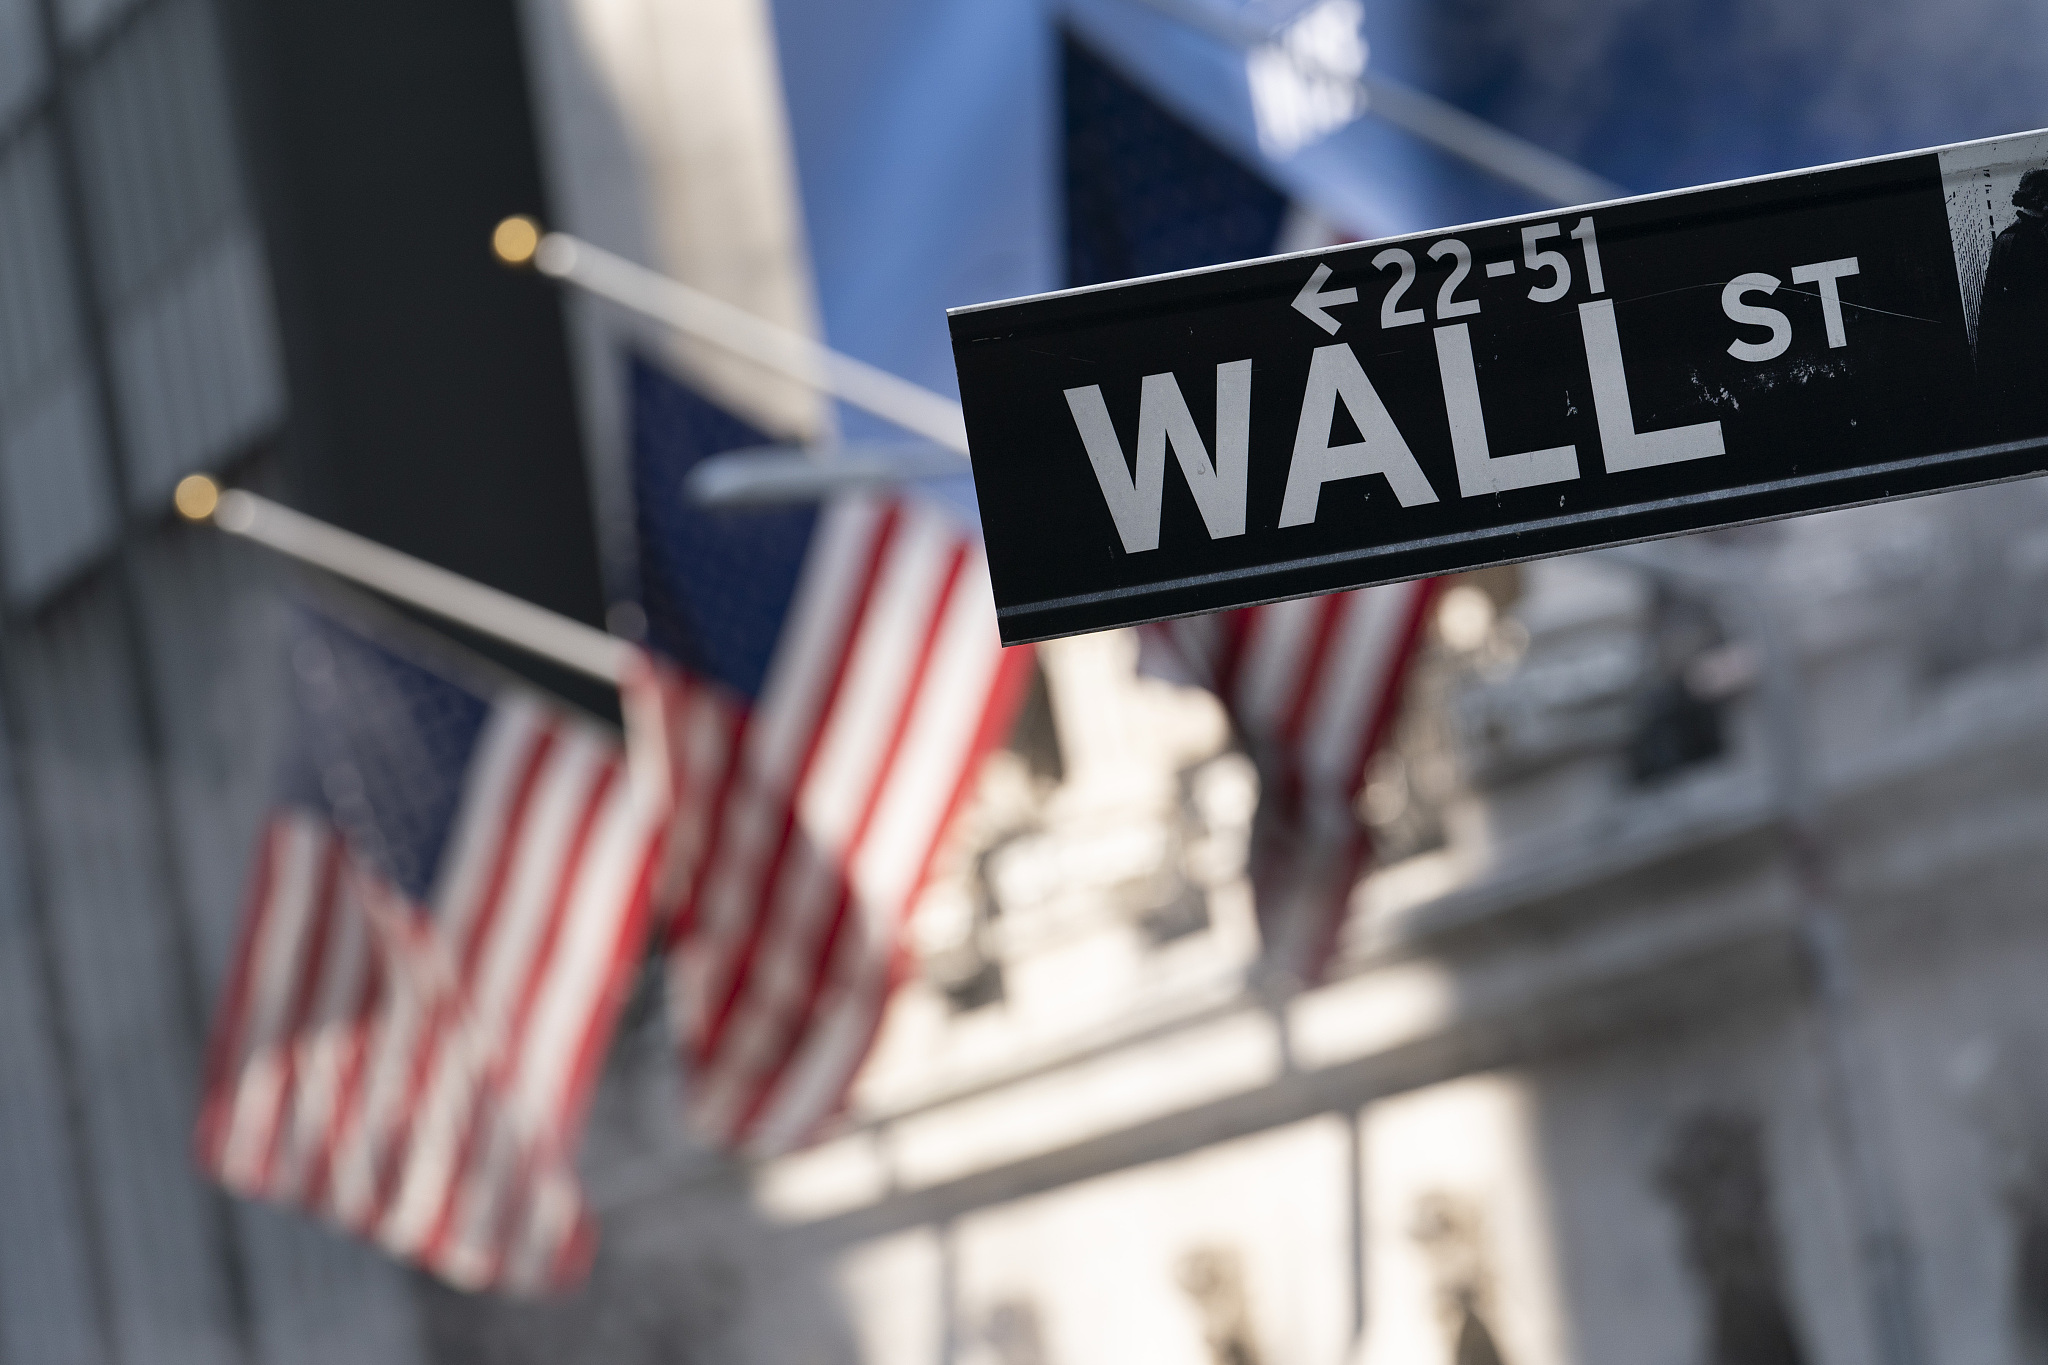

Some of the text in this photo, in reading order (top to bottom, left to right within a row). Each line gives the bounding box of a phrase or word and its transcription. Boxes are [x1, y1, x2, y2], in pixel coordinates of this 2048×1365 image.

[1372, 217, 1605, 329] 22-51
[1063, 257, 1859, 553] WALL ST
